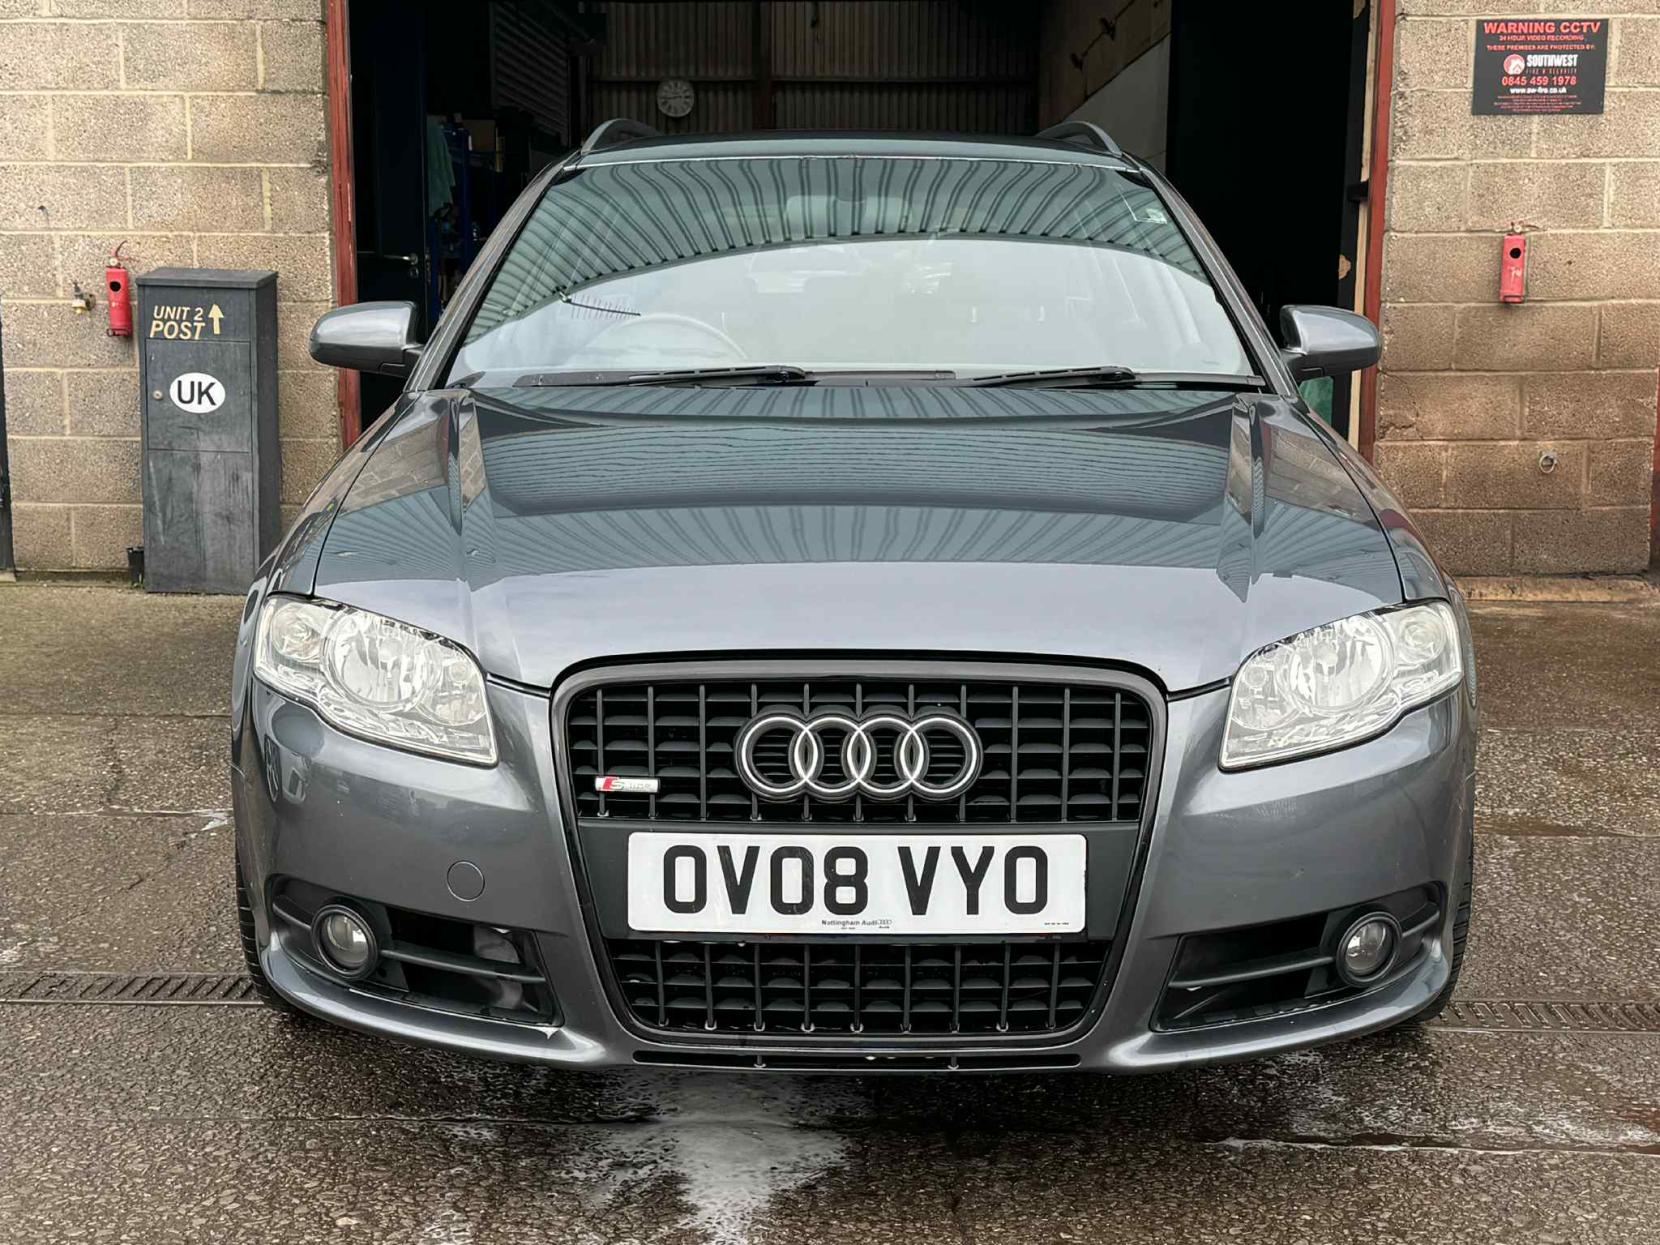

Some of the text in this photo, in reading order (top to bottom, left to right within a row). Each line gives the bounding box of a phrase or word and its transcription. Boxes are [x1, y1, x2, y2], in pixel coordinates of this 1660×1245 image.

[1484, 22, 1600, 34] WARNING CCTV
[1526, 54, 1578, 67] SOUTHWEST
[1501, 76, 1577, 86] 0845 459 1978
[153, 305, 204, 320] UNIT 2
[149, 320, 206, 340] POST
[177, 380, 216, 406] UK
[663, 845, 1048, 915] OV08 VYO
[821, 919, 860, 927] Nottingham
